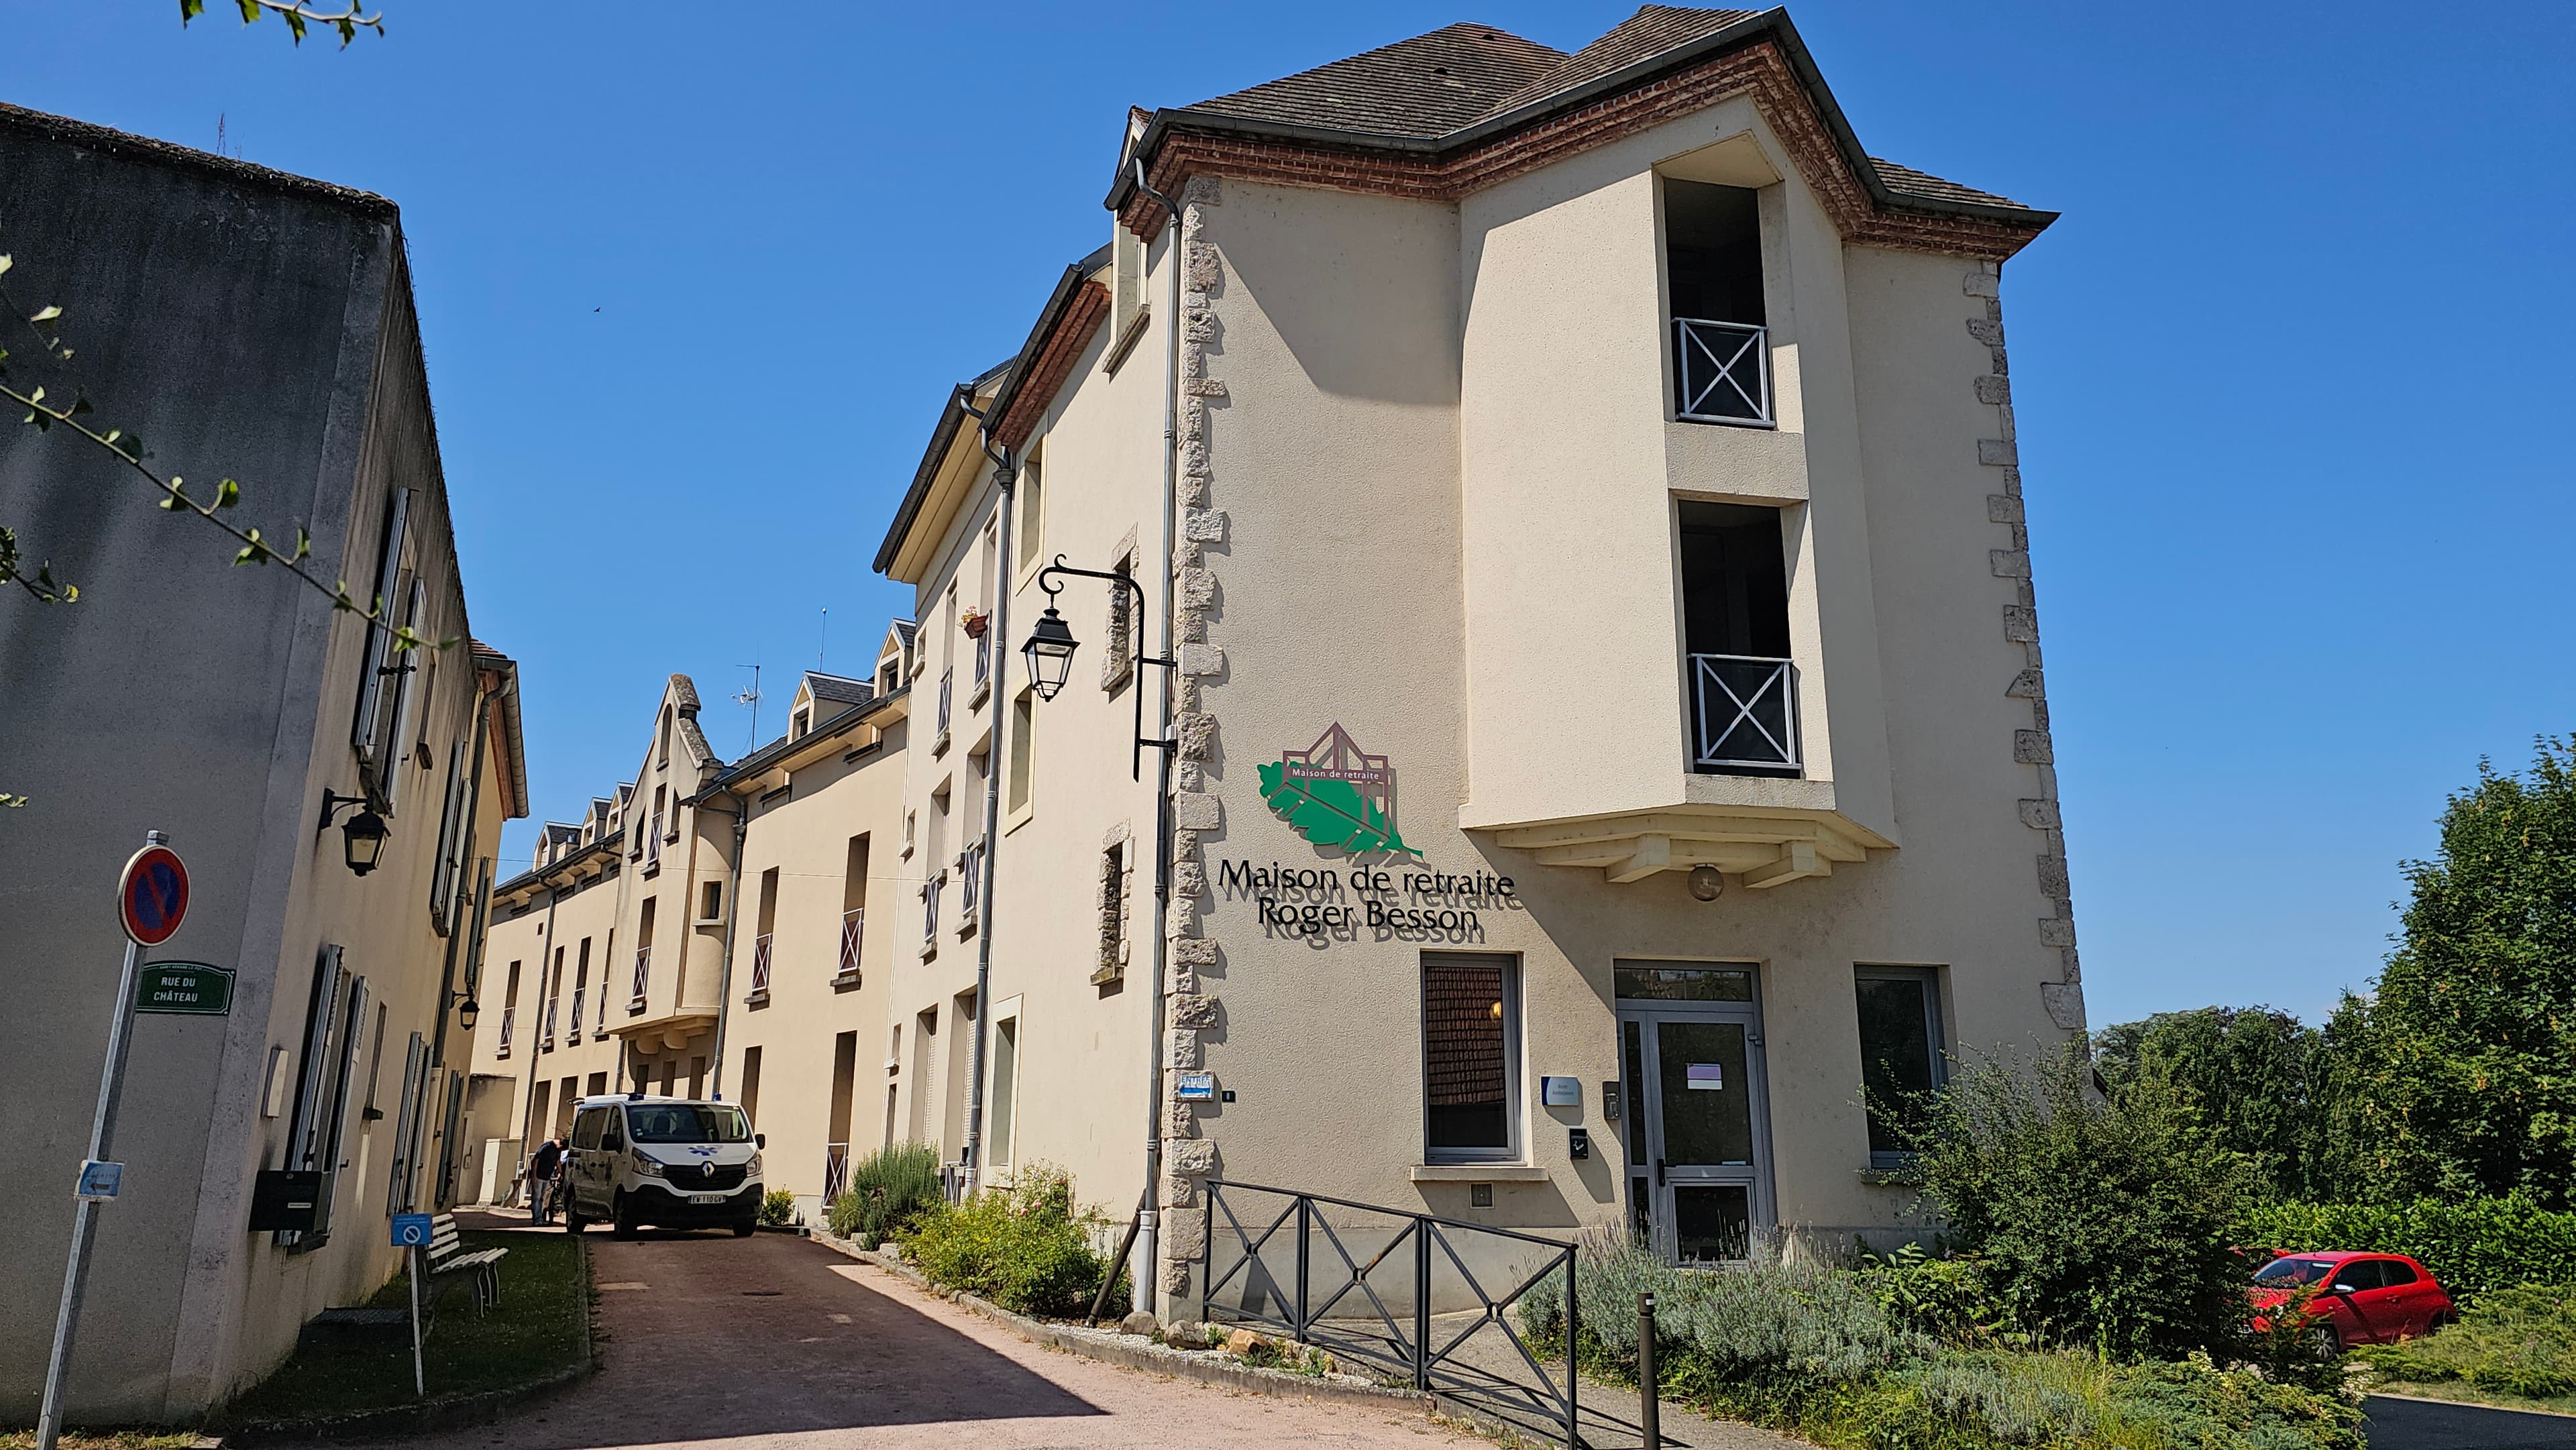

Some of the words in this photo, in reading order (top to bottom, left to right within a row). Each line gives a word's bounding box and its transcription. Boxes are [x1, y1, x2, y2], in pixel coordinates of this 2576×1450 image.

[1292, 768, 1326, 777] Maison
[1329, 770, 1341, 778] de
[1344, 771, 1379, 779] retraite
[1218, 859, 1338, 889] Maison
[1350, 864, 1391, 891] de
[1403, 869, 1515, 896] retraite
[1258, 897, 1355, 934] Roger
[1366, 900, 1478, 930] Besson
[161, 977, 180, 987] RUE
[182, 978, 196, 987] DU
[154, 990, 198, 1002] CHÂTEAU
